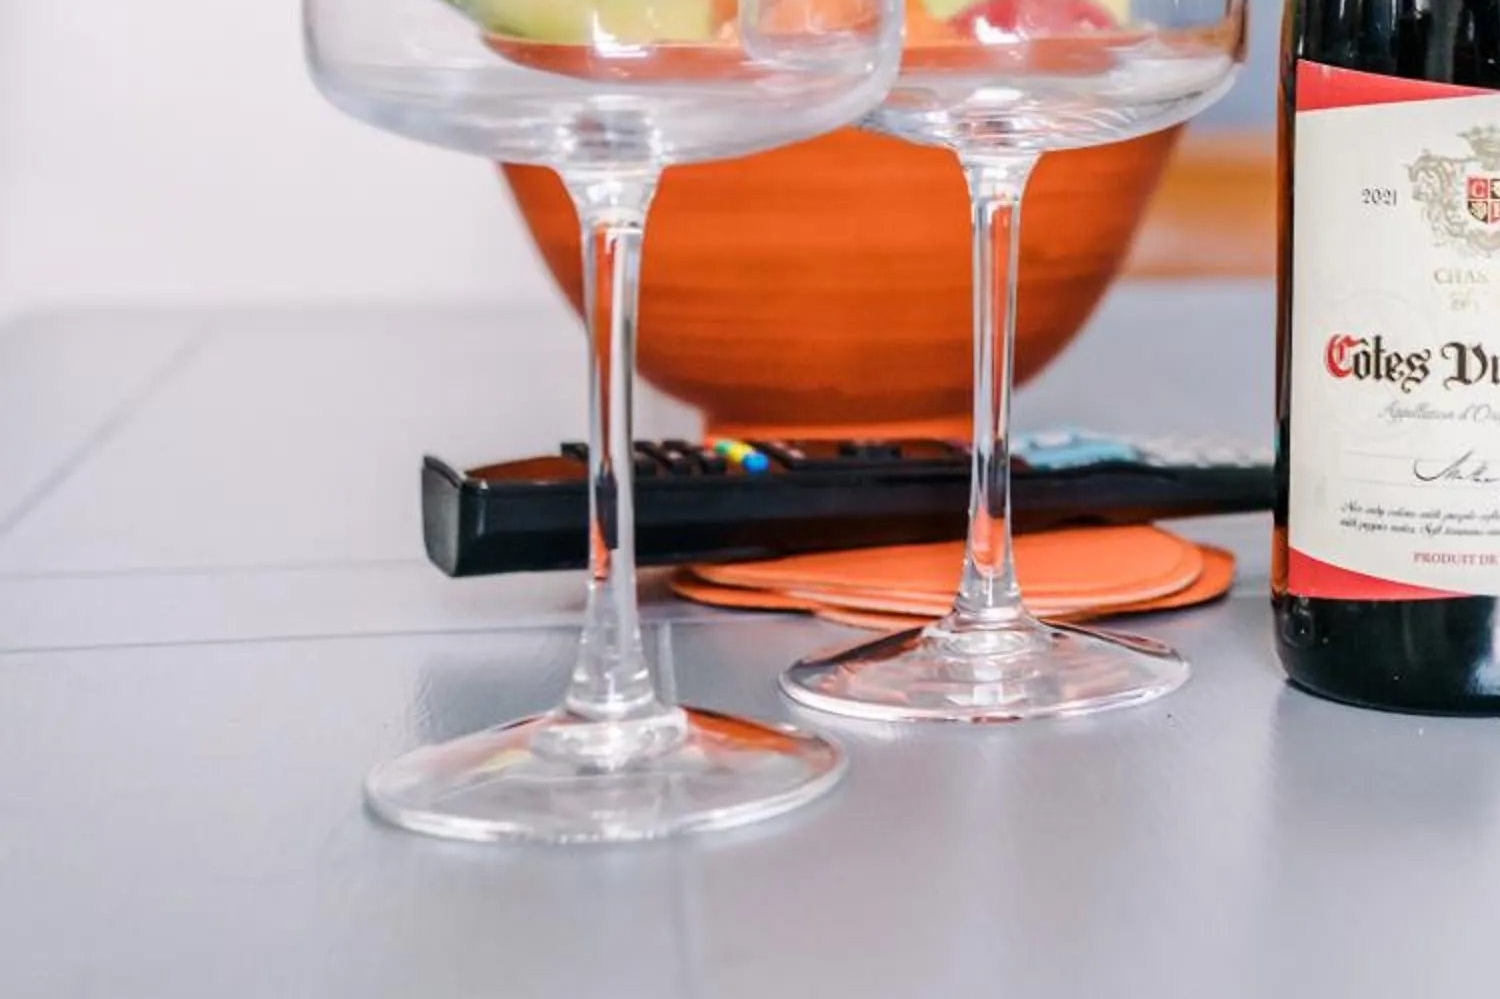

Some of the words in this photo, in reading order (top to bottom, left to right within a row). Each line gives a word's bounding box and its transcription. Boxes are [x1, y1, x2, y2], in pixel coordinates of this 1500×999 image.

[1361, 188, 1397, 206] 2021
[1323, 334, 1431, 393] Côtes
[1413, 552, 1475, 566] PRODUIT
[1478, 553, 1498, 566] DE
